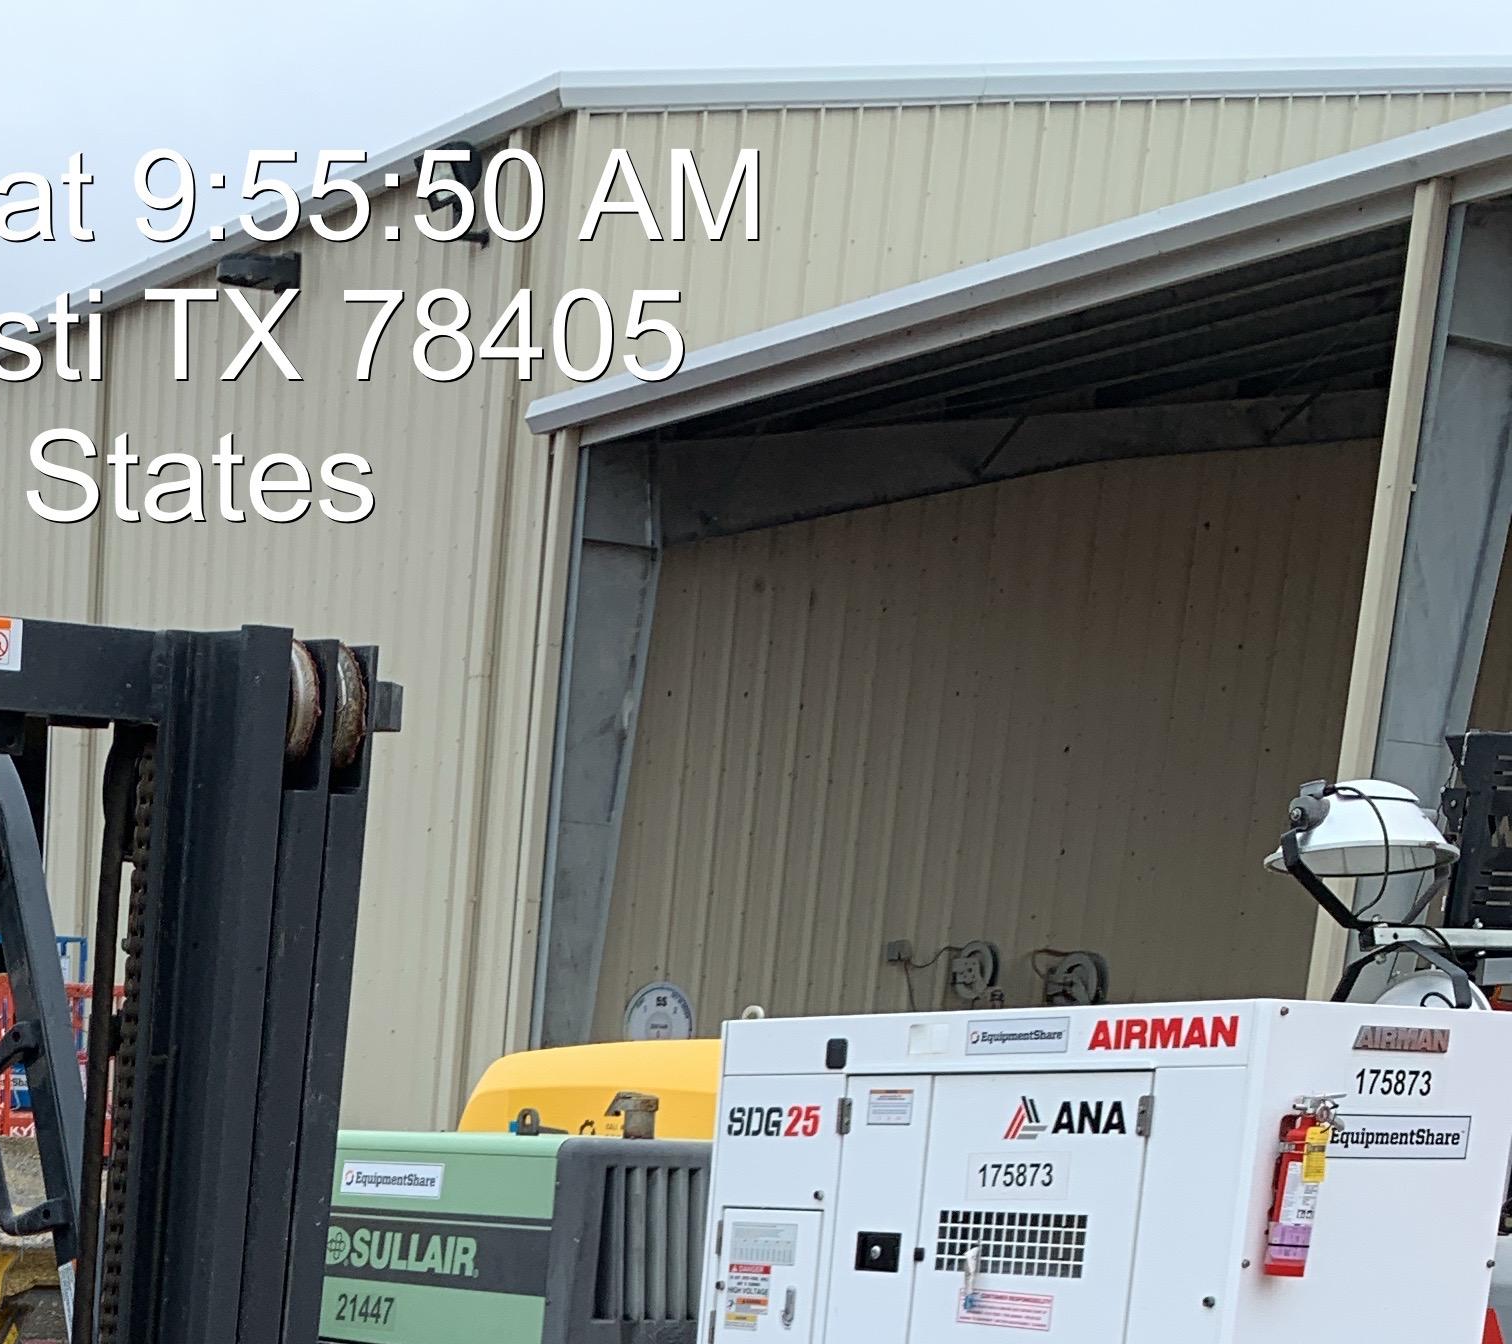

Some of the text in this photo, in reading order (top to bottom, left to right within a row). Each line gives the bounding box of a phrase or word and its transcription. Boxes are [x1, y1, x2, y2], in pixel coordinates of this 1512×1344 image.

[980, 1028, 1064, 1047] EquipmentShare
[1088, 1015, 1240, 1051] AIRMAN
[1355, 1026, 1449, 1052] AIRMAN
[1355, 1068, 1432, 1096] 175873
[1051, 1100, 1127, 1135] ANA
[1329, 1127, 1461, 1149] EquipmentShare
[355, 1171, 437, 1189] EquipmentShare
[977, 1162, 1054, 1188] 175873
[349, 1227, 477, 1278] SULLAIR
[335, 1293, 395, 1326] 21447
